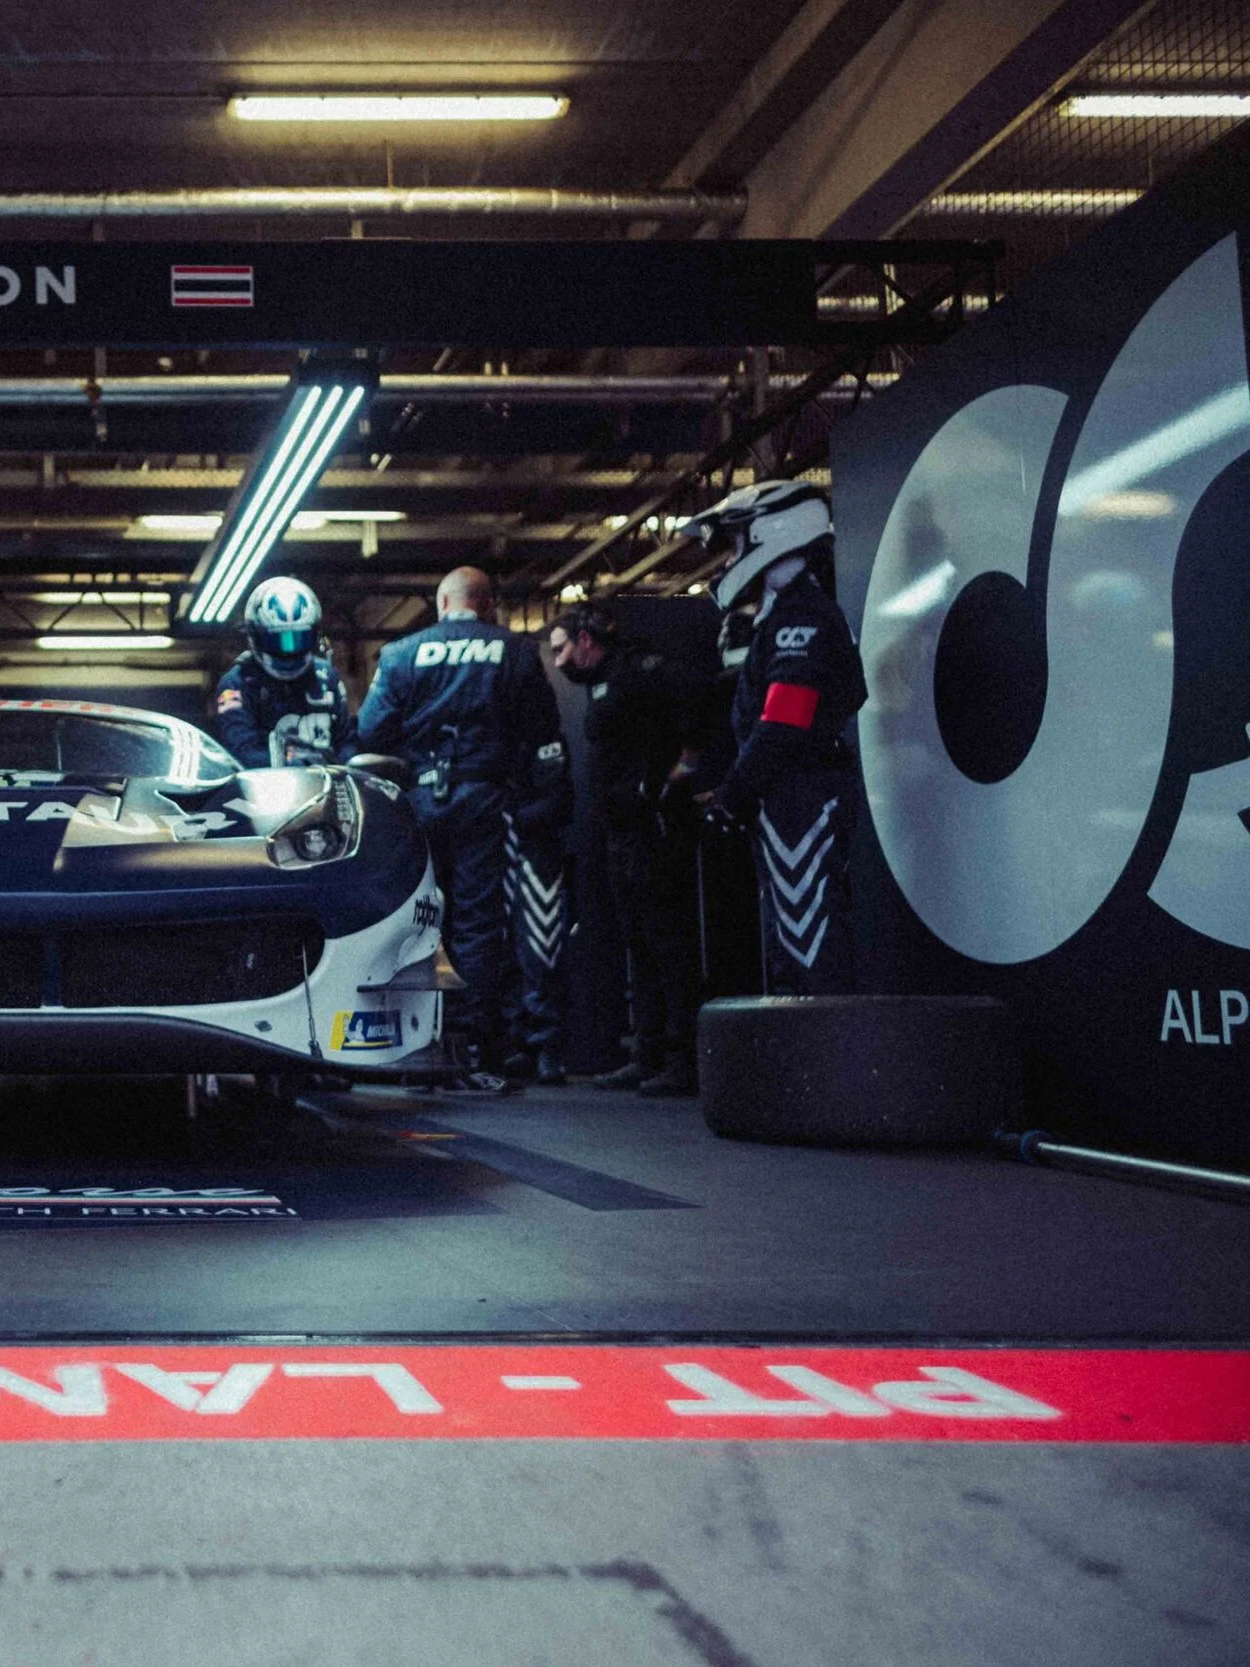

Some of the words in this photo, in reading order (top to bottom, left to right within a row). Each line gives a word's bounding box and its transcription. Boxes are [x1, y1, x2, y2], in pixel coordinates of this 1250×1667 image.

[414, 638, 505, 668] DTM
[1160, 988, 1250, 1045] ALP
[82, 1206, 299, 1216] FERRARI
[663, 1362, 1064, 1421] PIT
